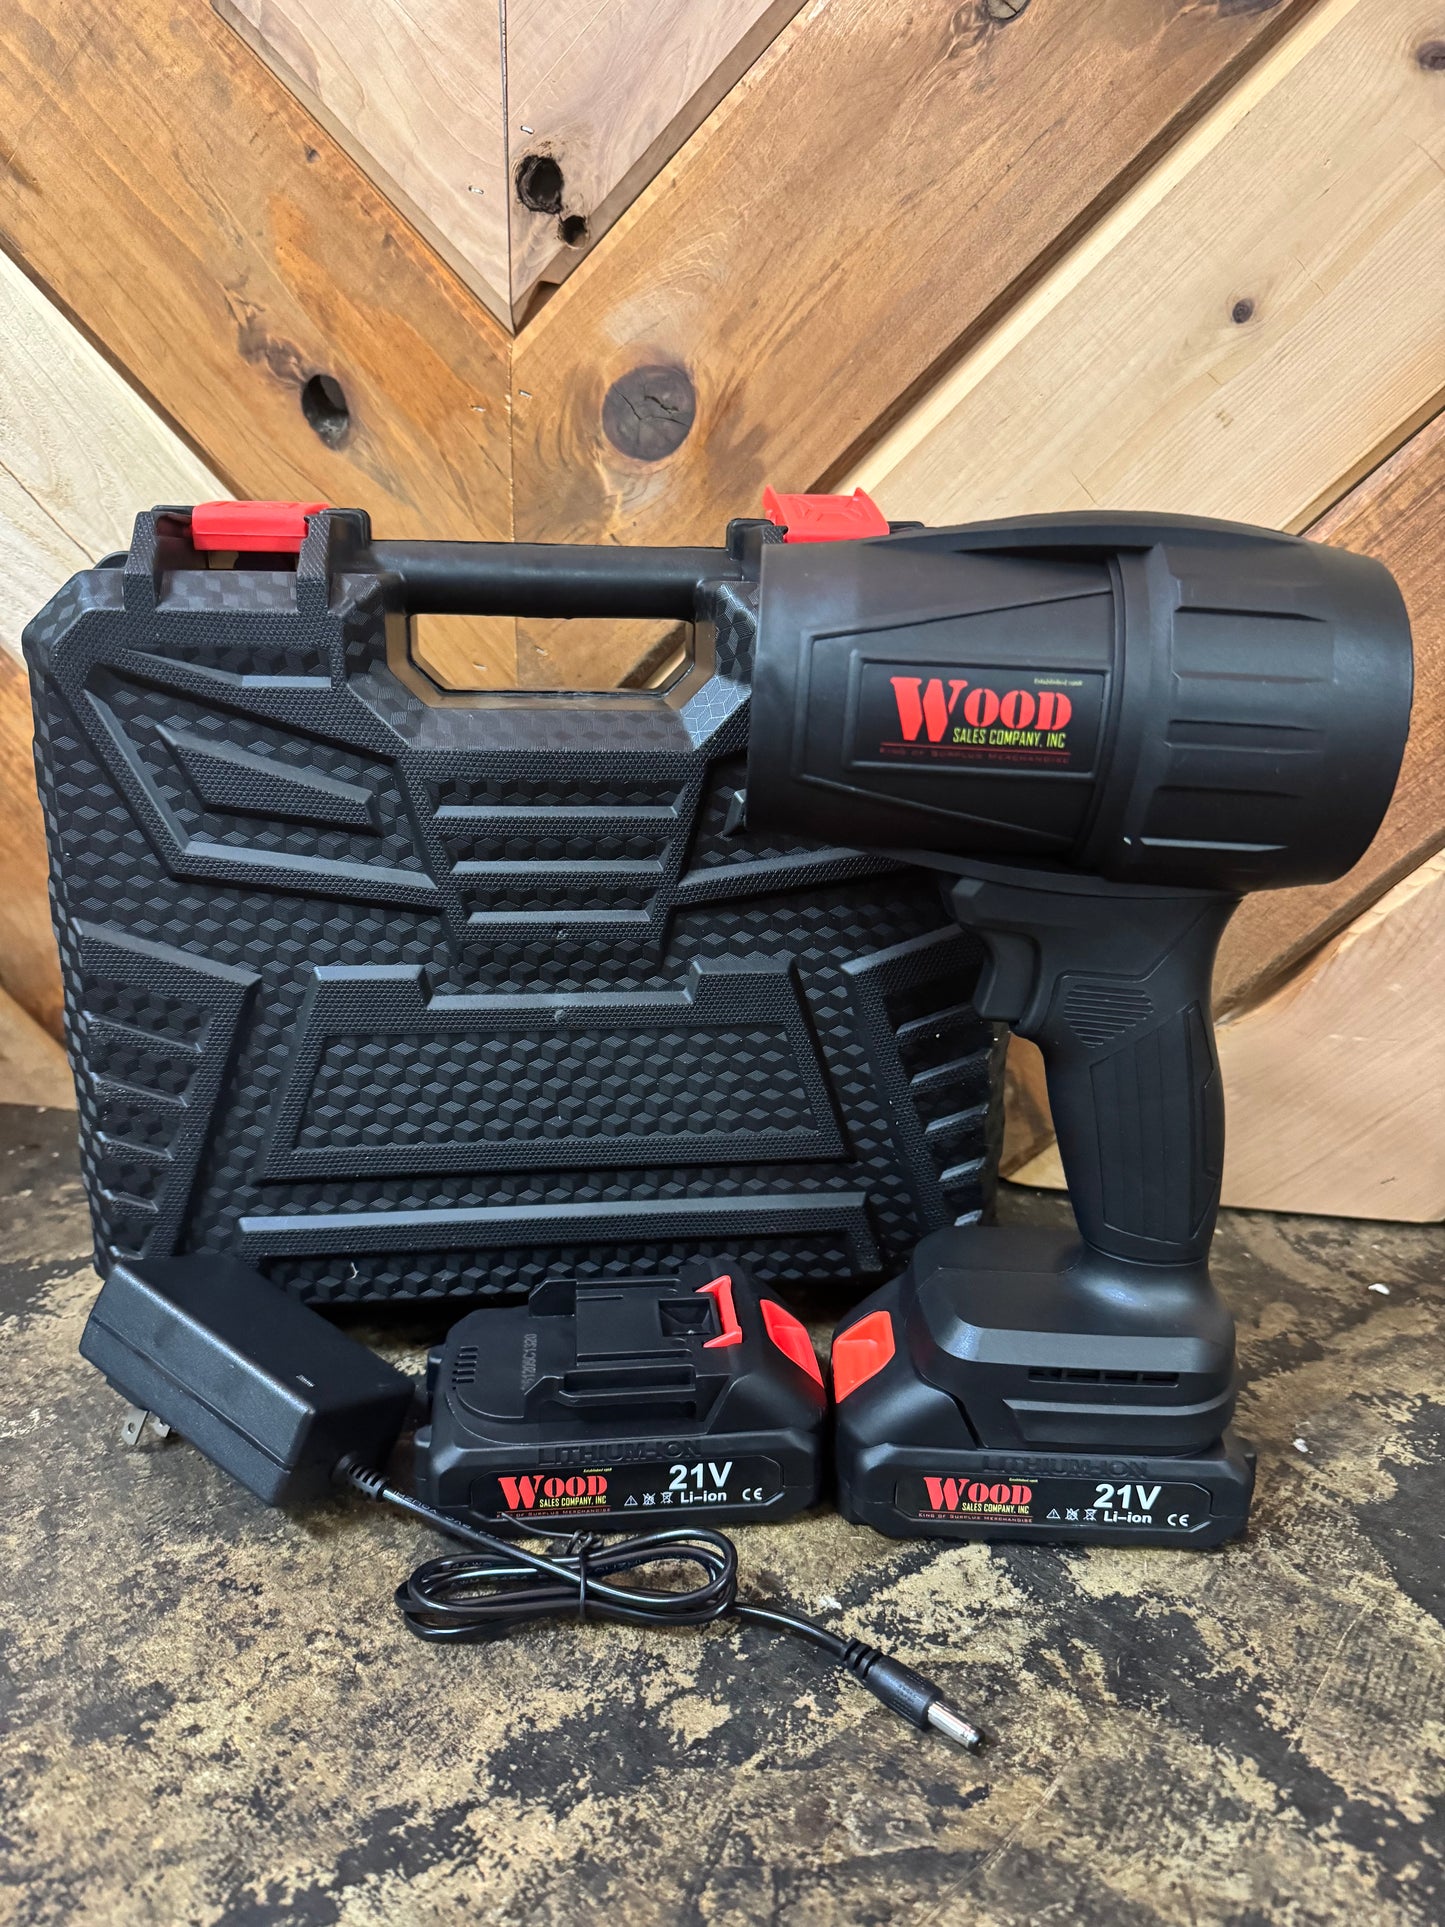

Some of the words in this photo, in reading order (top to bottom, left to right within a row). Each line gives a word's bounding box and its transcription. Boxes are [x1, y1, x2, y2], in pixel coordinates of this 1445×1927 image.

[890, 676, 1073, 743] WOOD
[952, 727, 986, 744] SALES
[1046, 732, 1066, 748] INC
[537, 1440, 702, 1467] LITHIUM-ION
[668, 1462, 733, 1490] 21V
[982, 1455, 1149, 1480] LITHIUM-ION
[497, 1475, 608, 1510] WOOD
[539, 1498, 560, 1508] SALES
[595, 1495, 607, 1505] INC
[680, 1490, 728, 1503] Li-ion
[923, 1476, 1033, 1511] WOOD
[1092, 1484, 1162, 1510] 21V
[961, 1502, 982, 1512] SALES
[1017, 1505, 1030, 1514] INC
[983, 1515, 1033, 1523] MERCHANDISE
[1104, 1509, 1153, 1525] Li-ion
